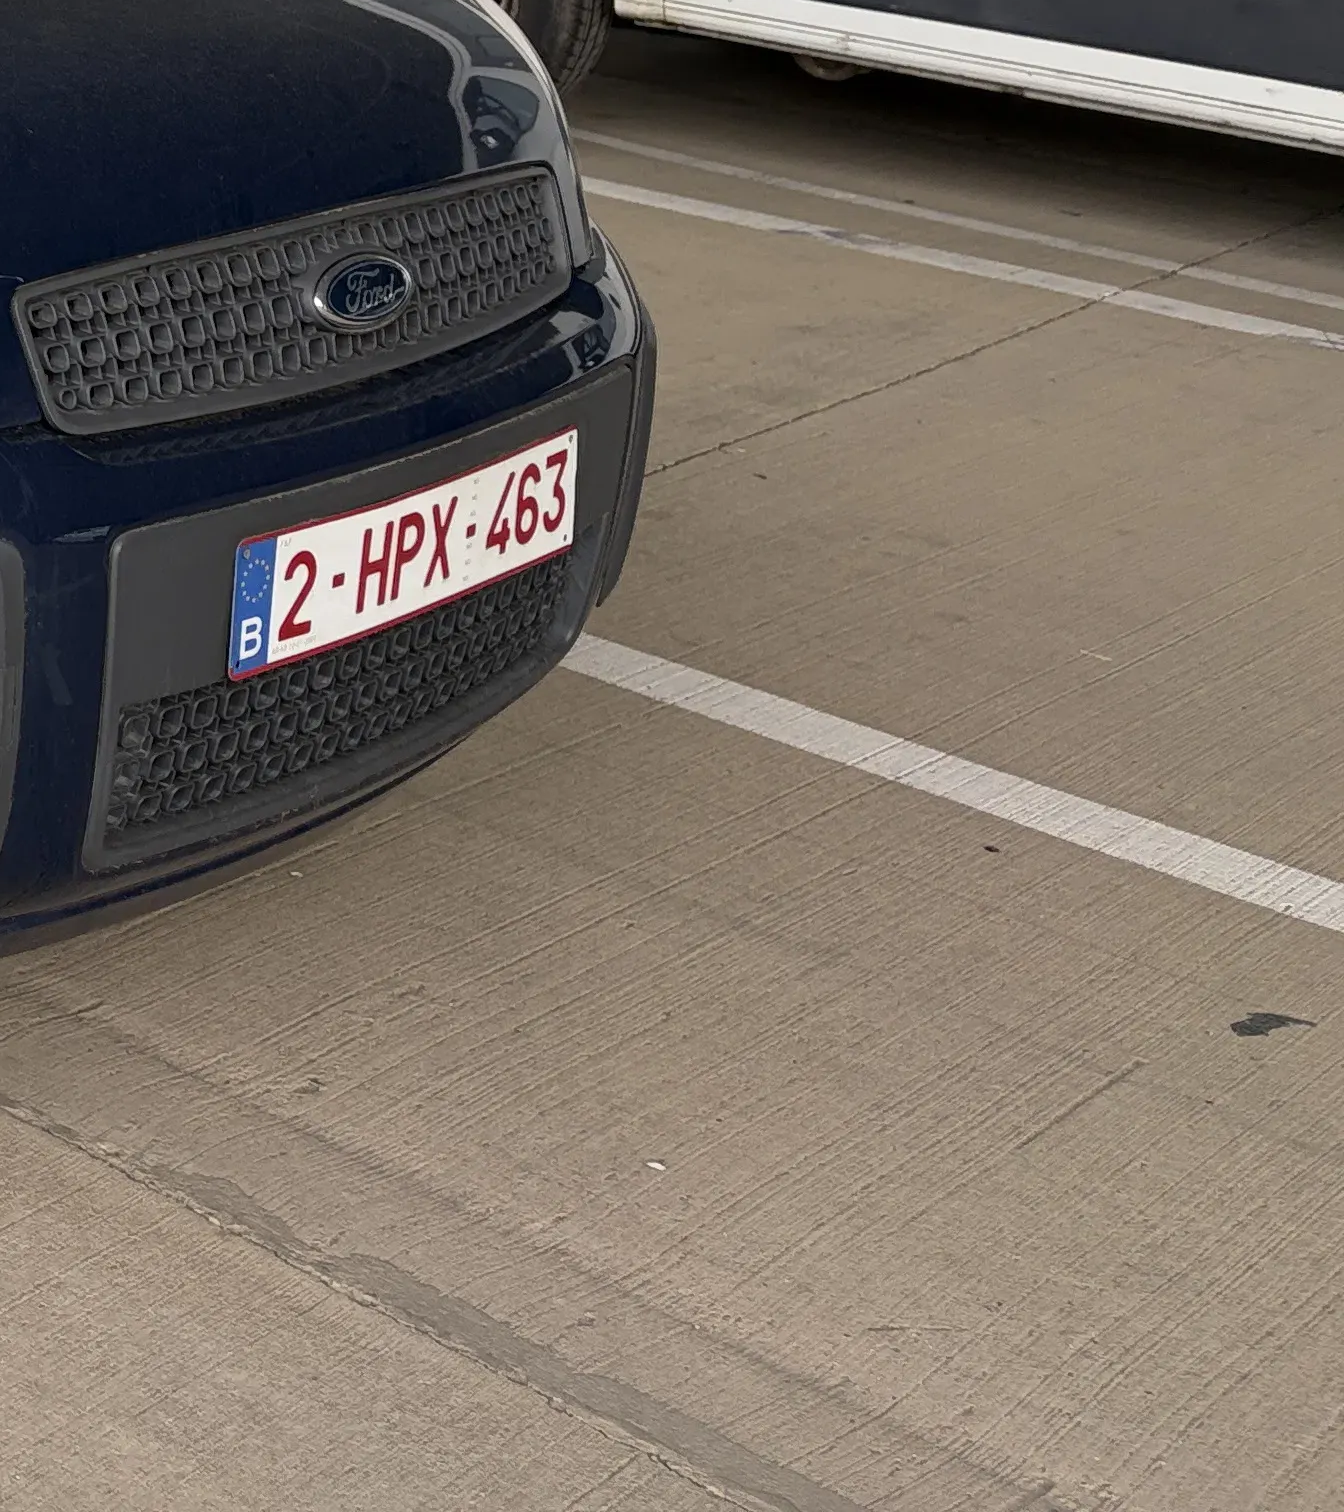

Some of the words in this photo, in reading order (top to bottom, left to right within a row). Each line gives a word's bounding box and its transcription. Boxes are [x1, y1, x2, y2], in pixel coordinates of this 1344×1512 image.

[345, 268, 405, 316] Ford
[278, 448, 569, 642] 2-HPX-463
[239, 616, 263, 661] B
